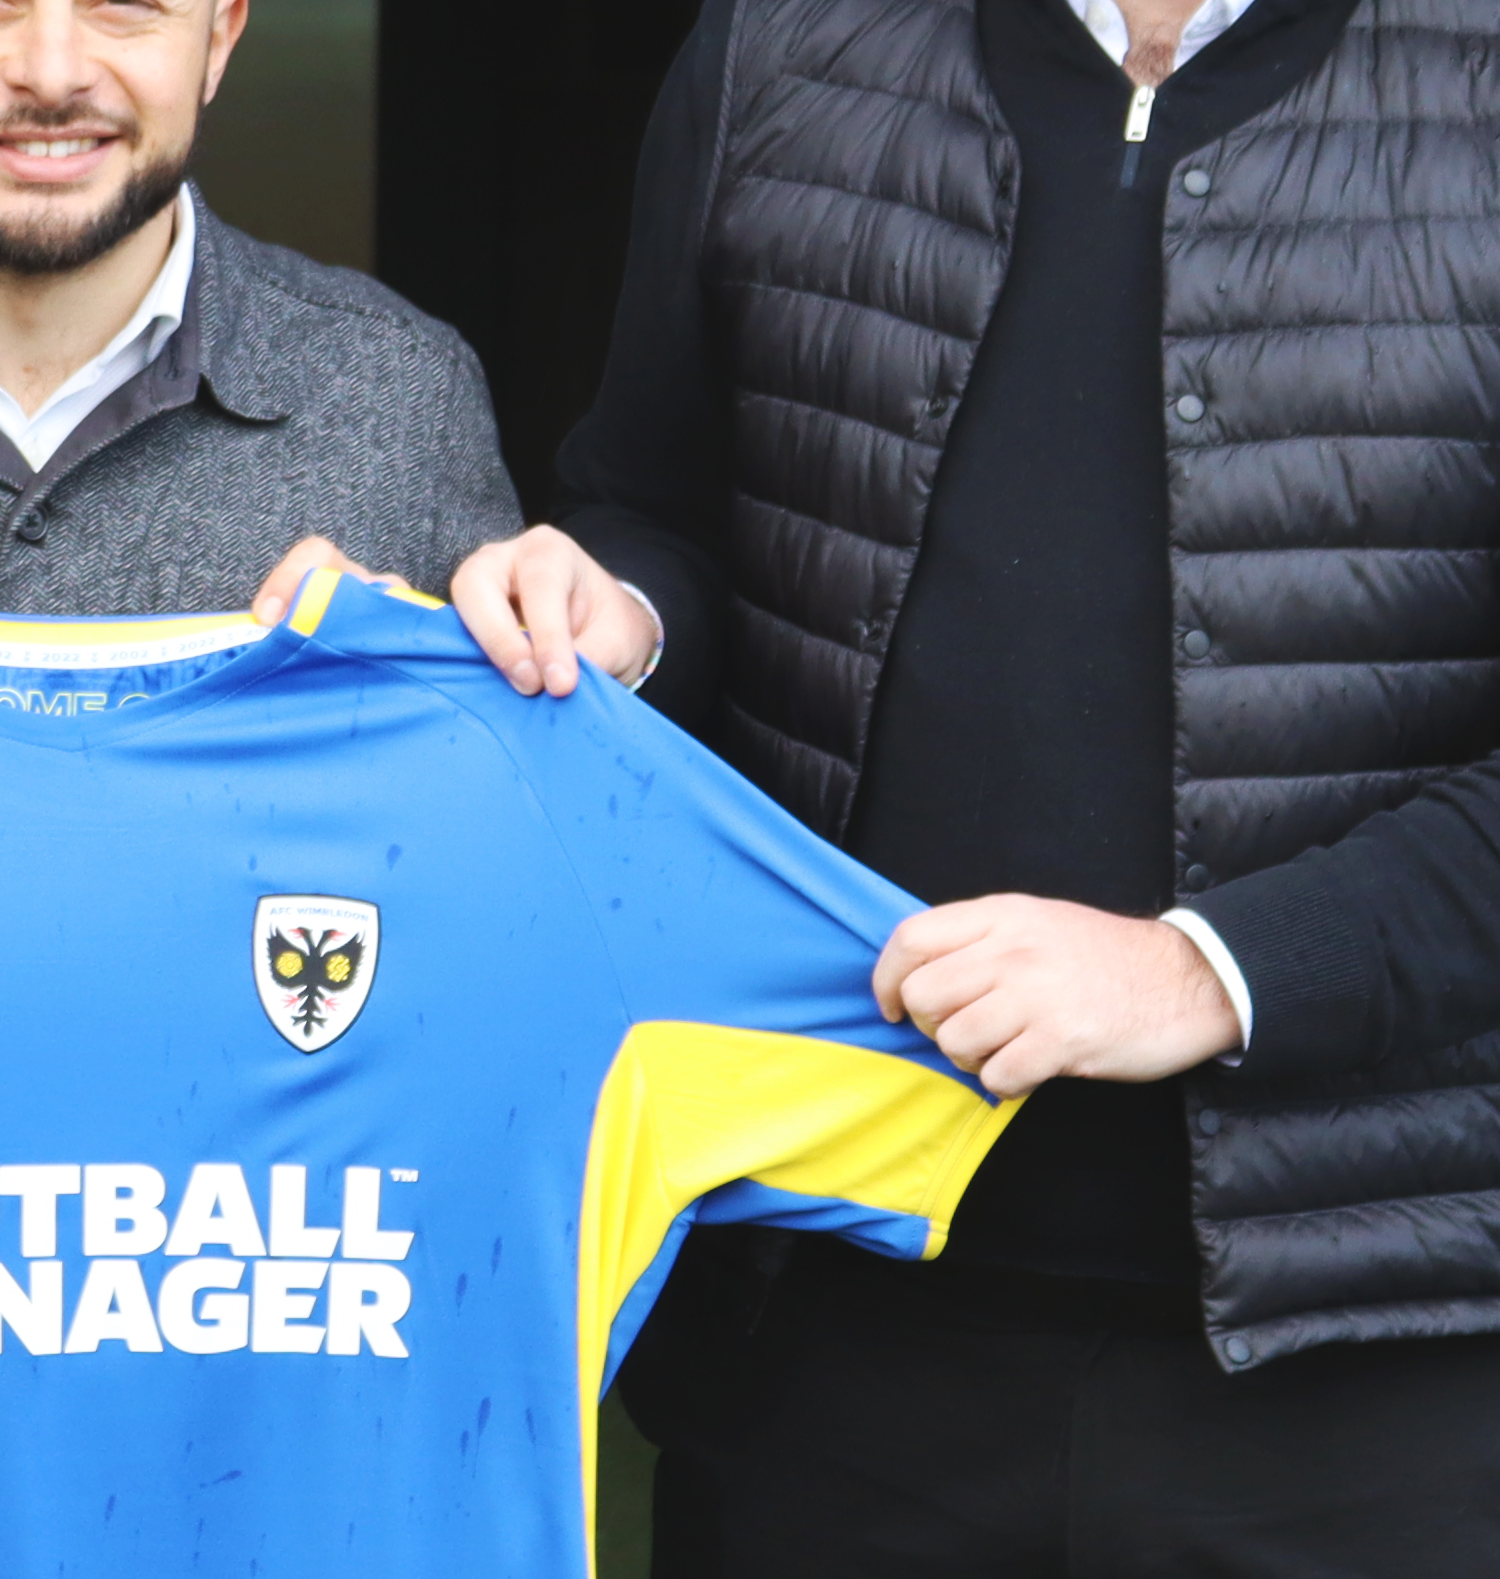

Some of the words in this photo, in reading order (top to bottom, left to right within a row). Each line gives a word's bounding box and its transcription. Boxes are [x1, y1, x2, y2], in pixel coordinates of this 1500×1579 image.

[41, 652, 81, 663] 2022
[109, 649, 149, 661] 2002
[178, 637, 216, 653] 2022
[269, 907, 292, 915] AFC
[297, 907, 369, 922] WIMBLEDON
